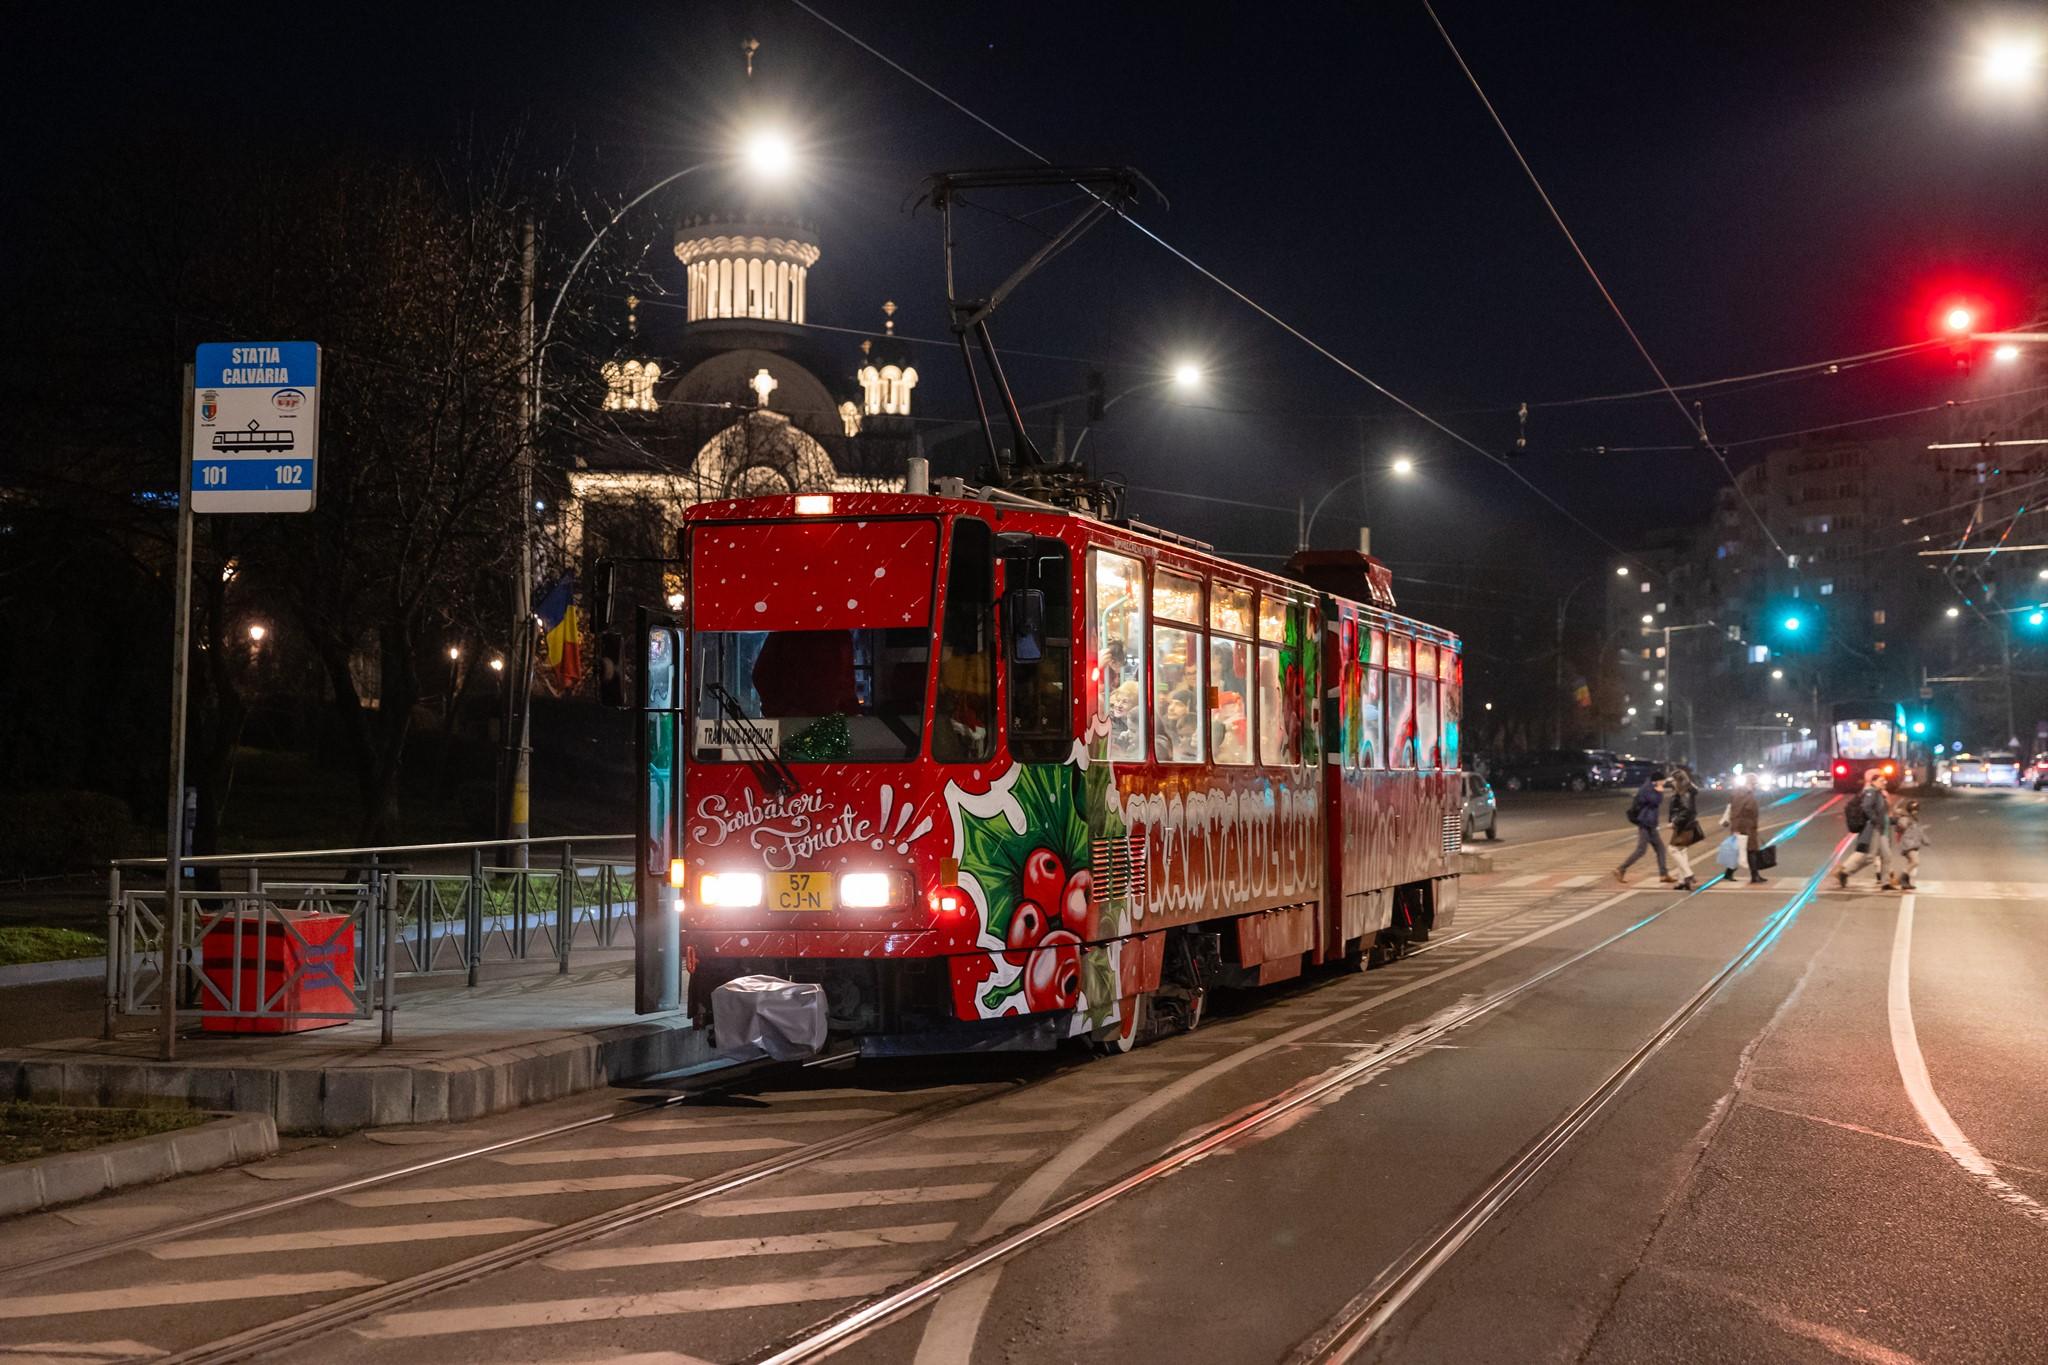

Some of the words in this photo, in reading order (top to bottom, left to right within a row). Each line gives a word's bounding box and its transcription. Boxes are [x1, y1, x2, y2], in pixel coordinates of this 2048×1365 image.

[222, 367, 289, 384] CALVARIA
[202, 466, 228, 485] 101
[274, 465, 302, 484] 102
[1126, 787, 1279, 920] TRAMVAIUL
[789, 875, 810, 891] 57
[779, 892, 821, 908] CJ-N
